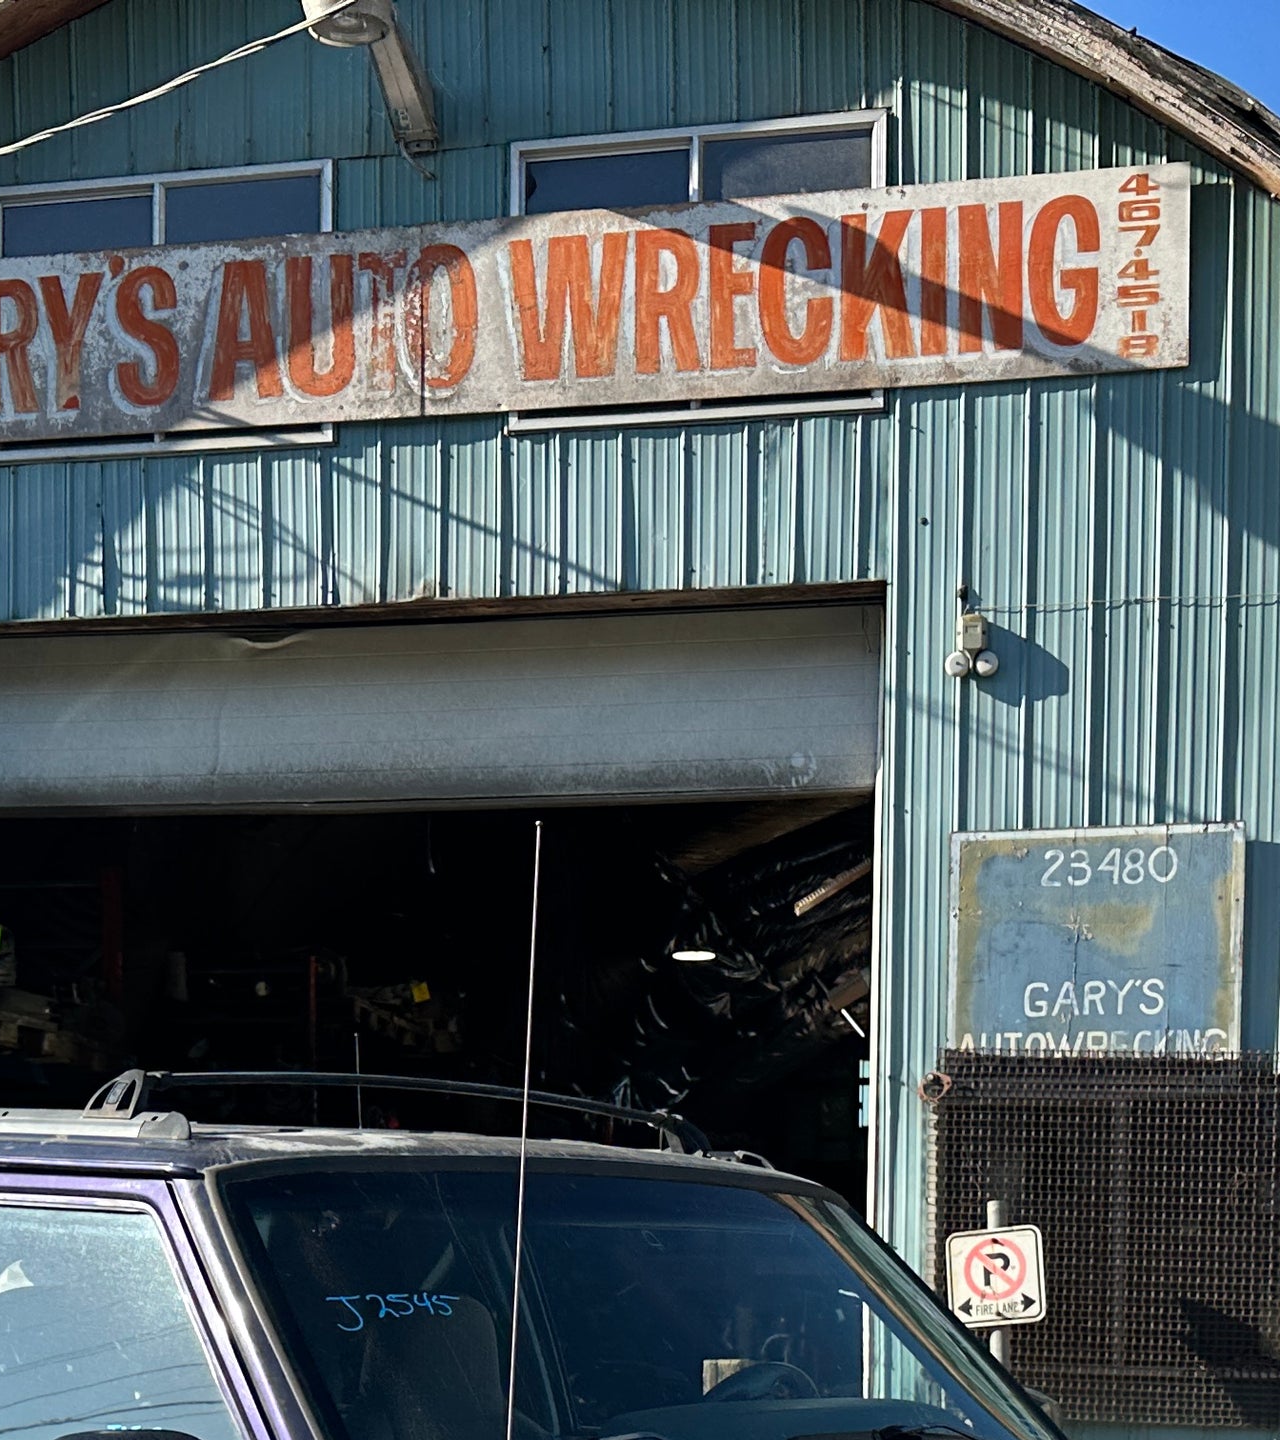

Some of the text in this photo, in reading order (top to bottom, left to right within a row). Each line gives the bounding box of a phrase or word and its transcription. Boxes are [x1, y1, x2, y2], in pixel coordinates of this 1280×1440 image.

[211, 243, 478, 400] AUTO
[510, 193, 1101, 381] WRECKING
[1041, 846, 1178, 887] 23480
[1023, 977, 1165, 1018] GARY'S
[326, 1292, 460, 1332] J2545
[975, 1304, 993, 1316] FIRE
